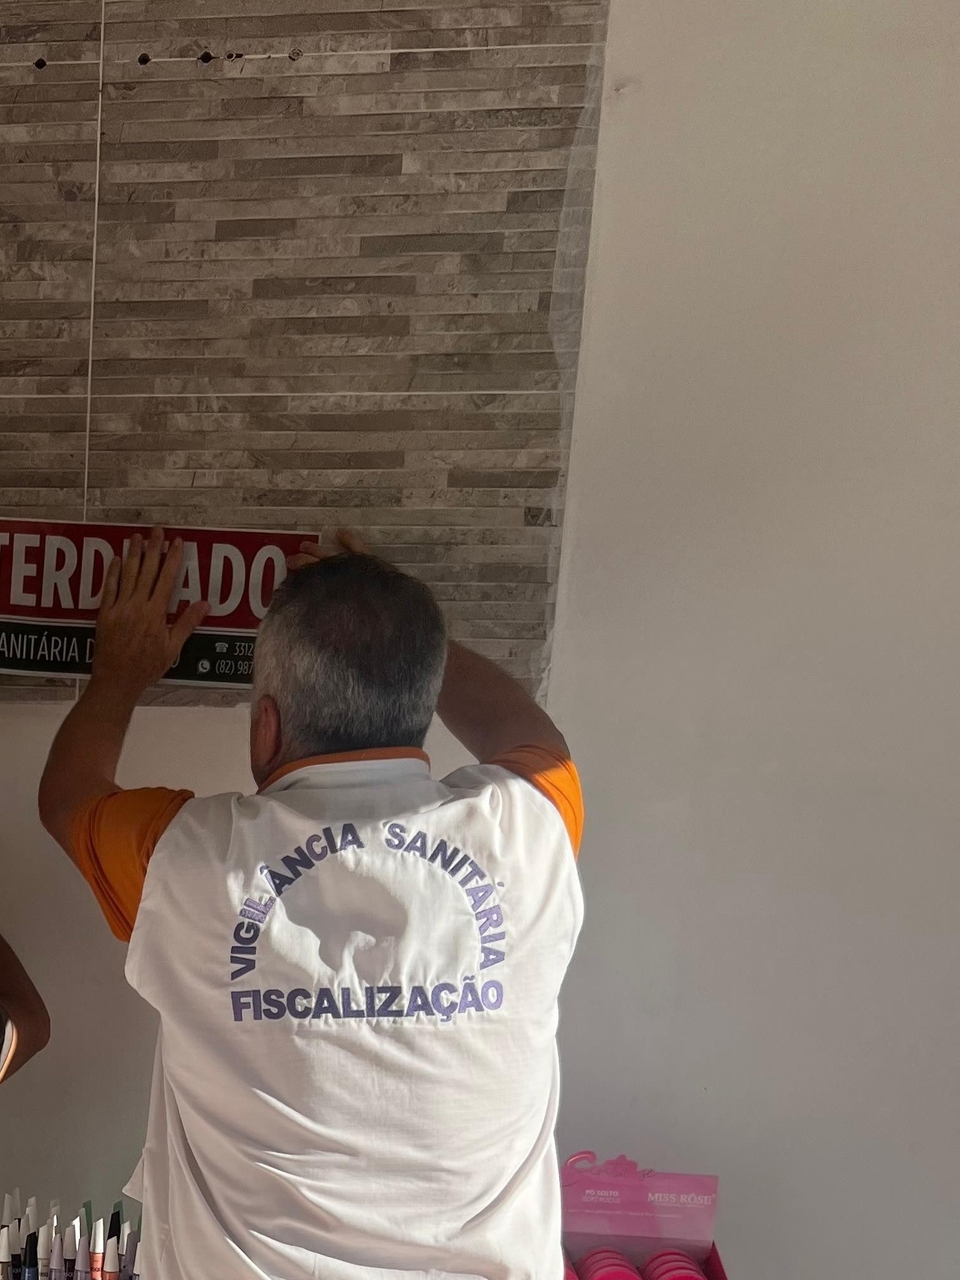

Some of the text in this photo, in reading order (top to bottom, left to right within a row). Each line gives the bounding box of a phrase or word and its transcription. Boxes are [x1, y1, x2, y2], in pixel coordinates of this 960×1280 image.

[214, 660, 254, 676] (82) 987
[229, 821, 506, 981] VIGILÂNCIA SANITÁRIA
[230, 975, 504, 1023] FISCALIZAÇÃO
[647, 1192, 677, 1203] MISS
